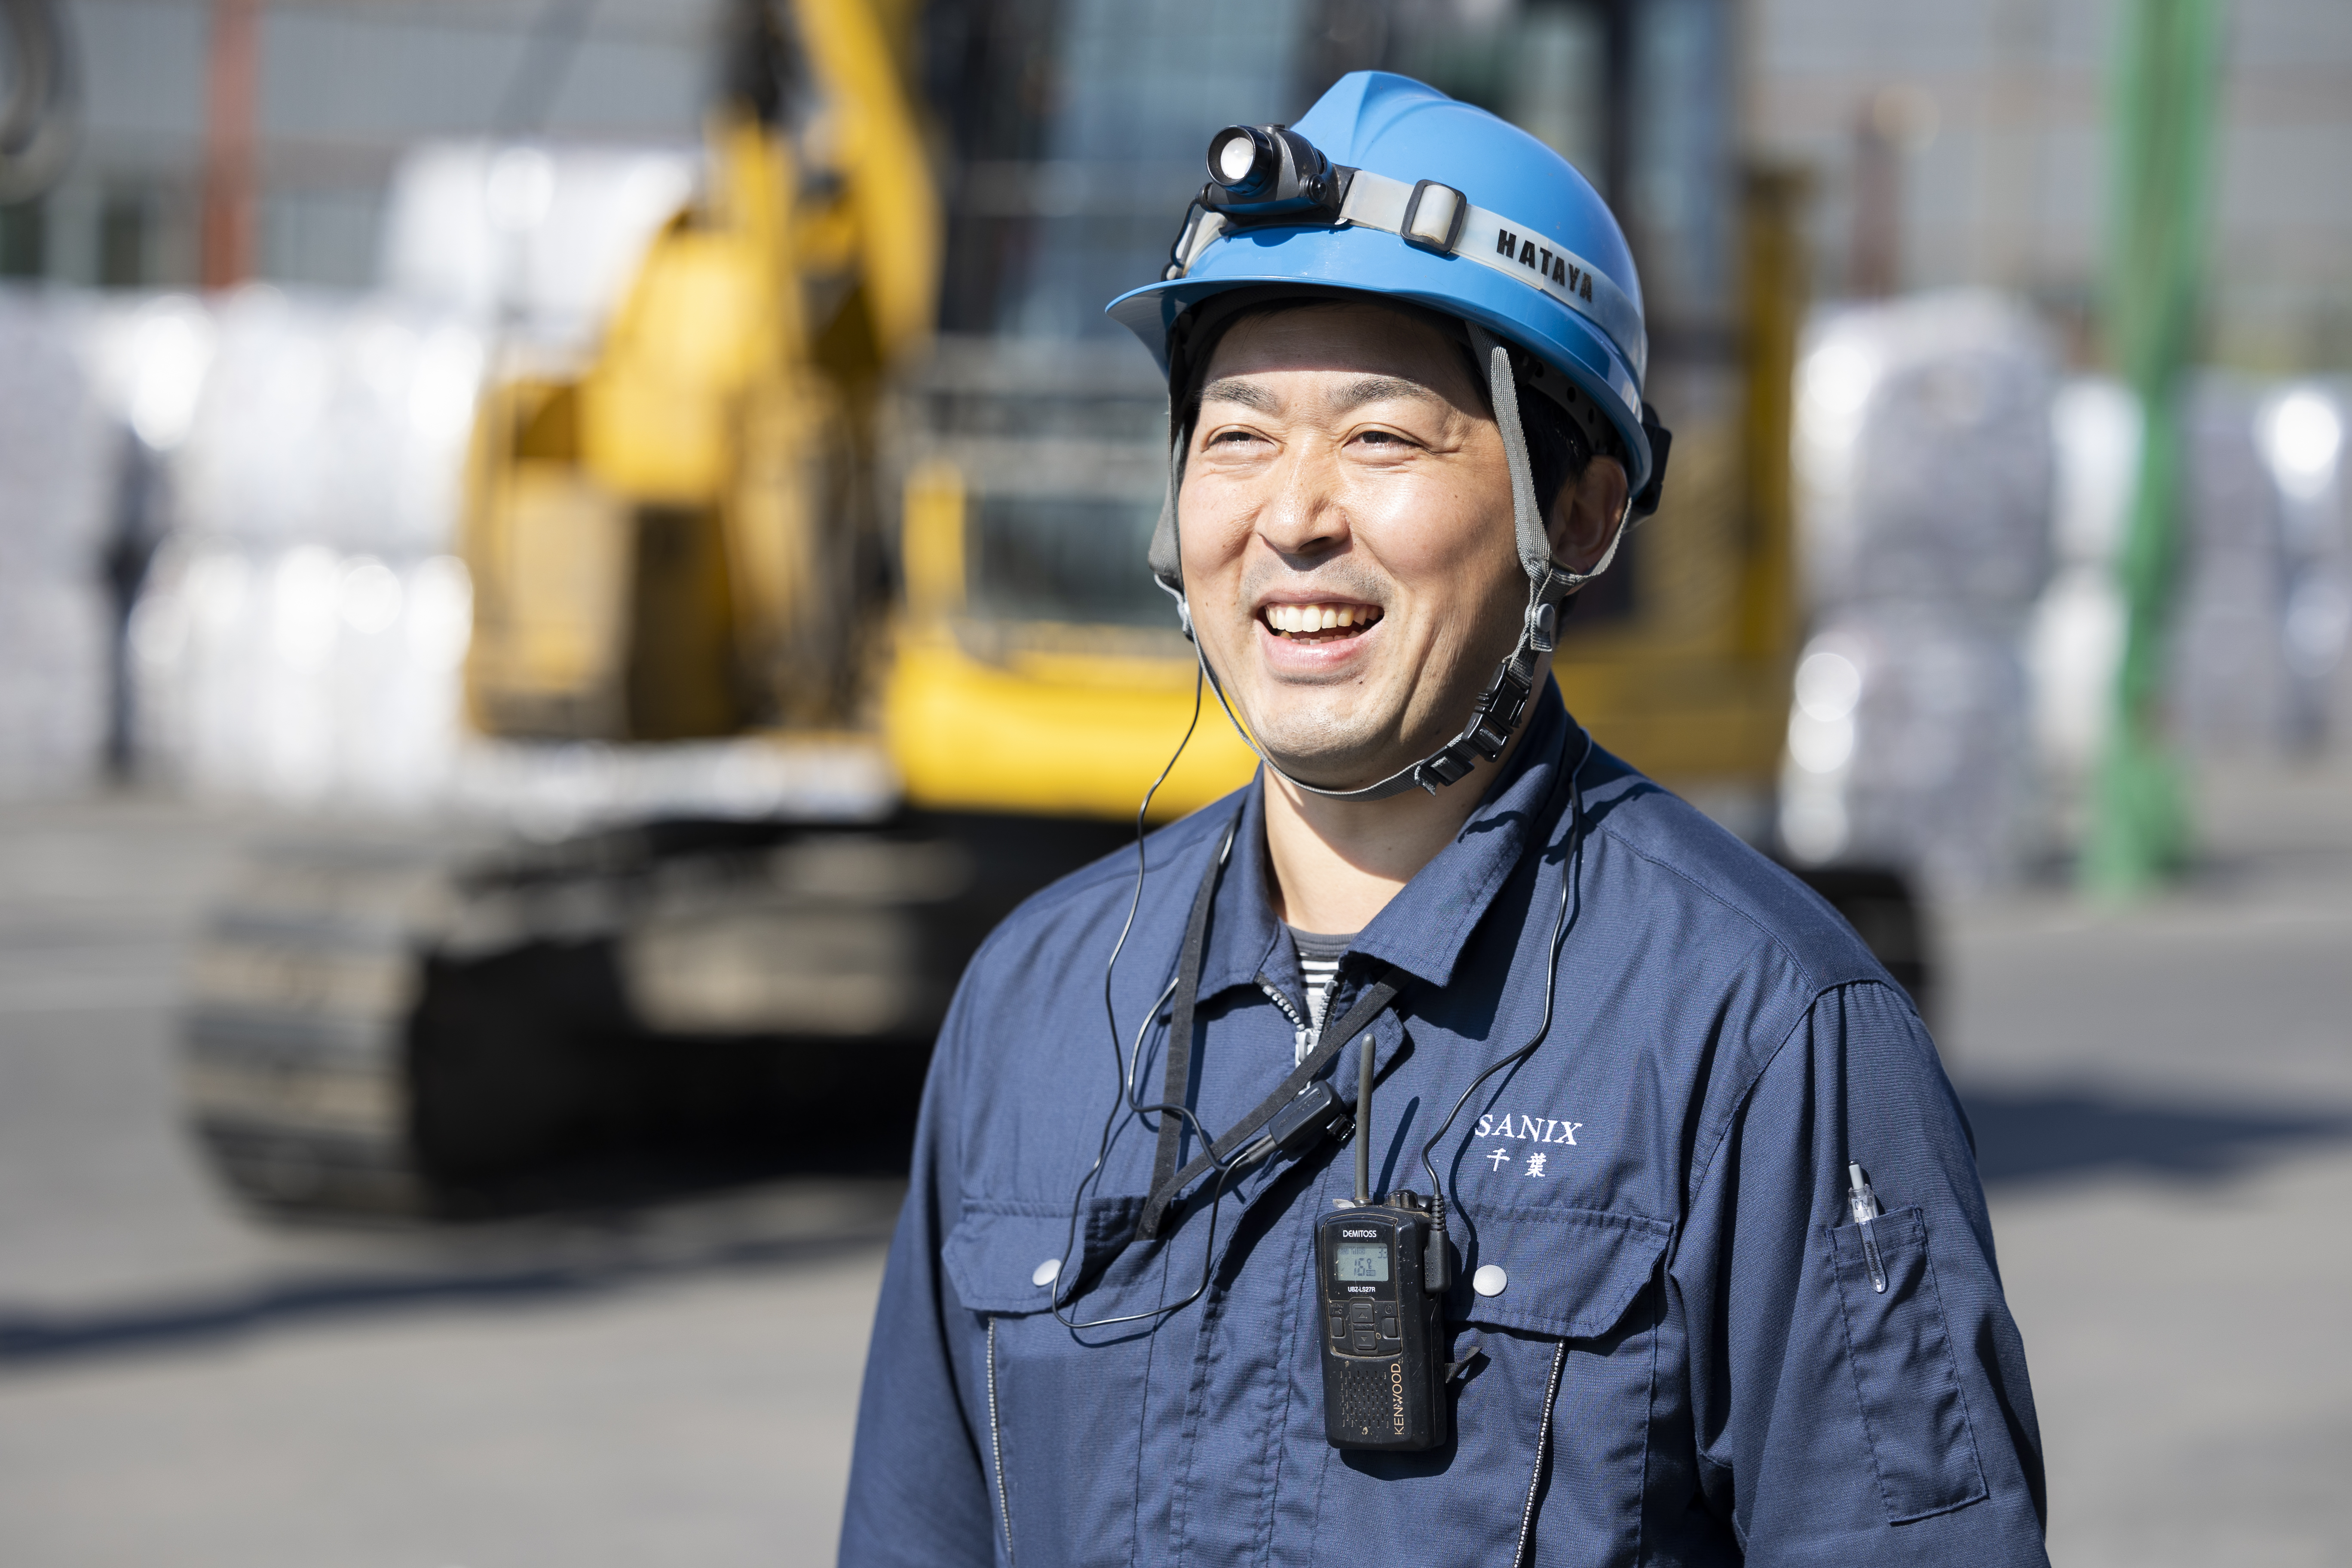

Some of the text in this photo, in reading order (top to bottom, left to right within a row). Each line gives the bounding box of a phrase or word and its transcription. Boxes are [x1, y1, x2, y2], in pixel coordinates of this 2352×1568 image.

[1496, 228, 1592, 303] HATAYA
[1475, 1113, 1583, 1146] SANIX
[1487, 1148, 1547, 1178] 千葉
[1391, 1363, 1404, 1435] KENWOOD
